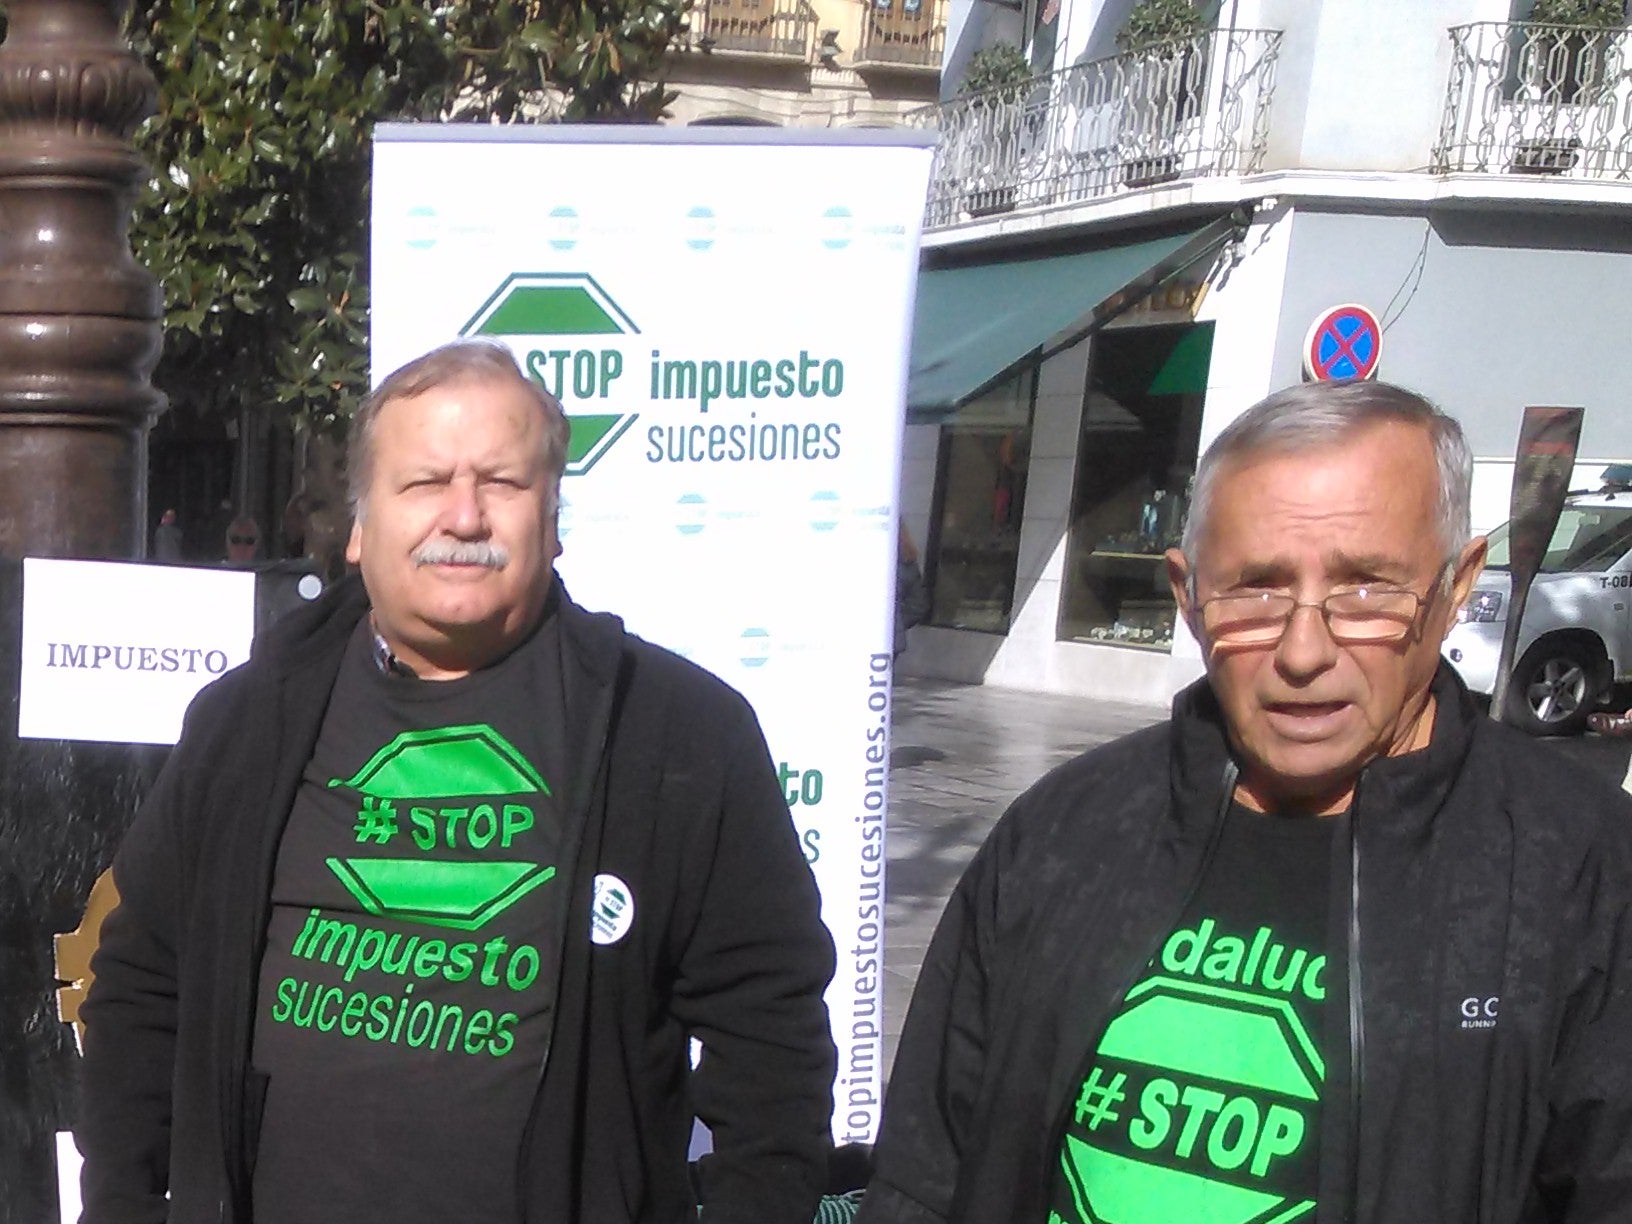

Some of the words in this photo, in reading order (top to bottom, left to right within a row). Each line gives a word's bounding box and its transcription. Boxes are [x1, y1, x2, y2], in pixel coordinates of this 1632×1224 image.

[526, 349, 624, 400] STOP
[650, 350, 844, 413] impuesto
[646, 412, 842, 463] sucesiones
[46, 642, 229, 675] IMPUESTO
[409, 803, 536, 852] STOP
[840, 652, 892, 1142] topimpuestosucesiones.org
[291, 908, 540, 992] impuesto
[271, 977, 520, 1058] sucesiones
[1128, 1077, 1306, 1178] STOP
